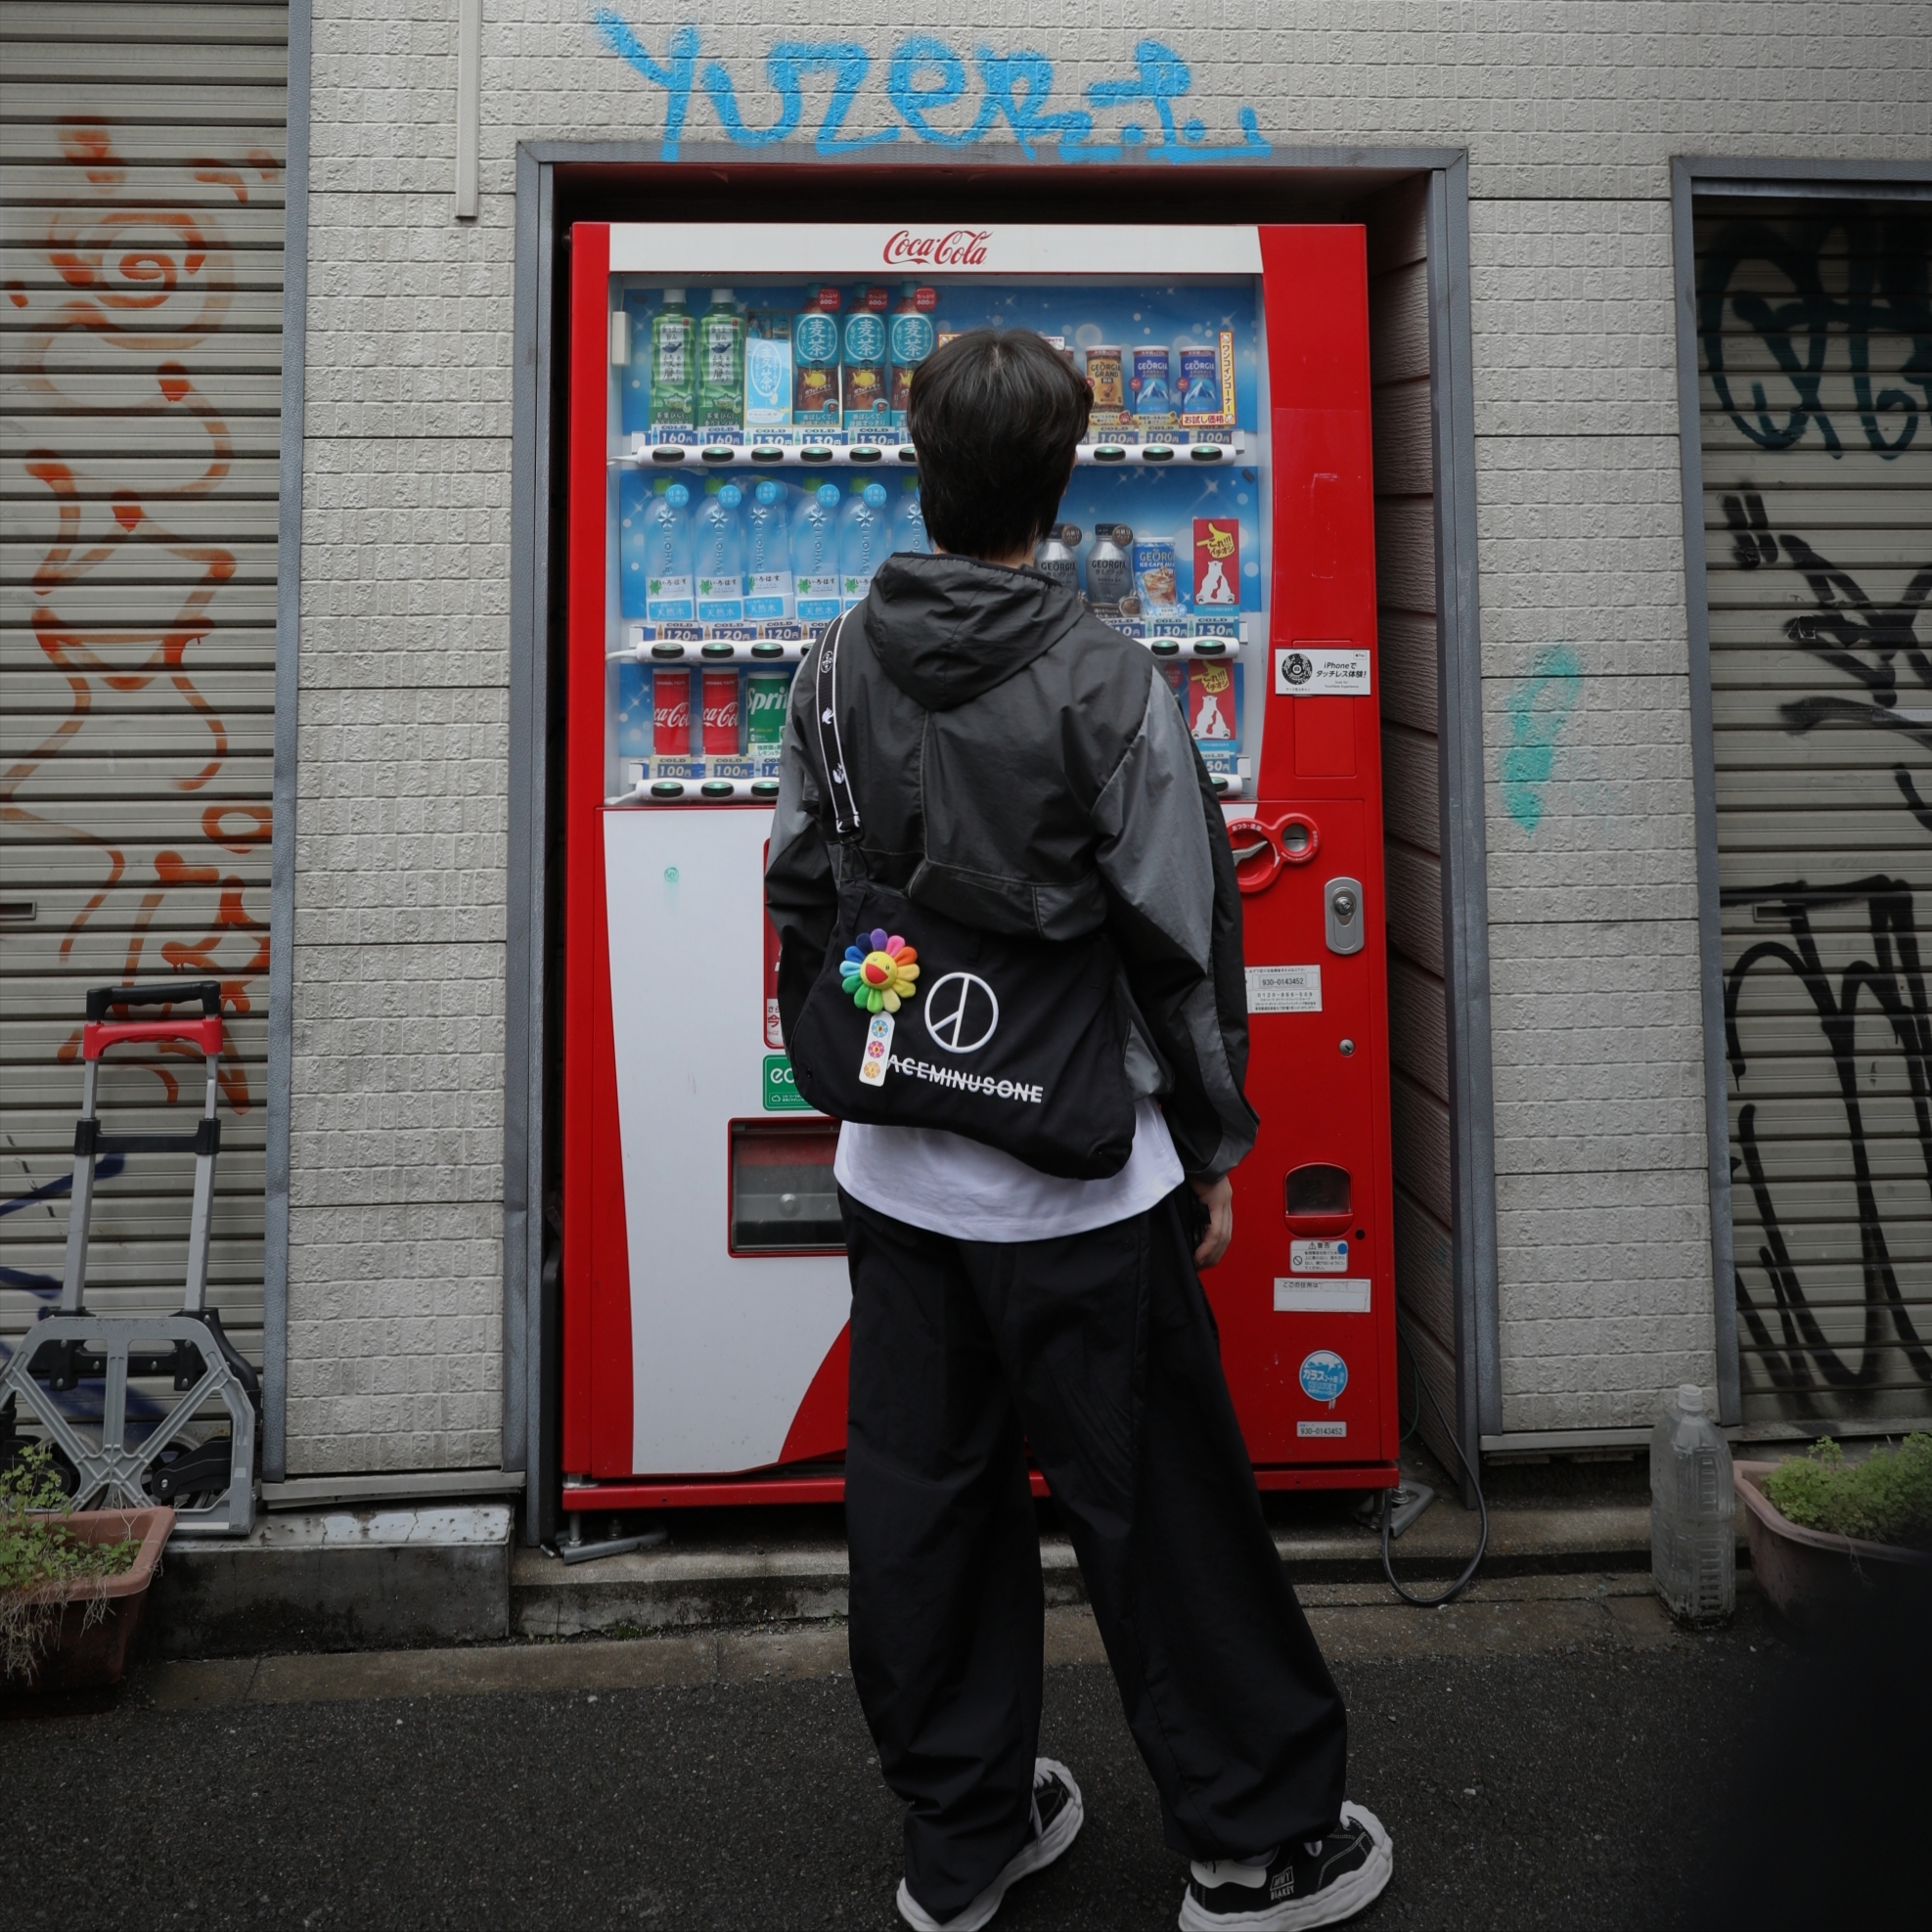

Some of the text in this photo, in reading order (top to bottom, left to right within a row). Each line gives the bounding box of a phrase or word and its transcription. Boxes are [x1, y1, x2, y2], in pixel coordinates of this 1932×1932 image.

[882, 230, 994, 265] Coca-Cola
[808, 320, 827, 356] 麦茶
[857, 320, 876, 356] 麦茶
[904, 320, 922, 356] 麦茶
[1223, 344, 1232, 413] ワンコインコーナー
[661, 432, 693, 445] 160円
[709, 435, 741, 446] 160円
[756, 436, 792, 445] 130円
[805, 436, 840, 445] 130円
[860, 435, 895, 445] 130円
[1101, 433, 1134, 444] 100円
[1148, 433, 1179, 443] 100円
[1199, 432, 1230, 443] 100円
[1211, 546, 1234, 557] イチオシ
[1041, 562, 1075, 571] GEORGIA
[1092, 560, 1126, 569] GEORGIA
[657, 607, 685, 617] 天然水
[707, 607, 735, 617] 天然水
[750, 605, 776, 613] 天然水
[805, 607, 833, 616] 天然水
[666, 630, 697, 641] 120円
[714, 630, 749, 641] 120円
[768, 629, 798, 639] 120円
[1155, 626, 1187, 636] 130円
[1198, 625, 1234, 636] 130円
[1204, 681, 1228, 691] イチオシ
[659, 766, 692, 777] 100円
[716, 766, 747, 777] 100円
[1262, 977, 1304, 986] 930-0143452
[768, 1014, 781, 1028] 今
